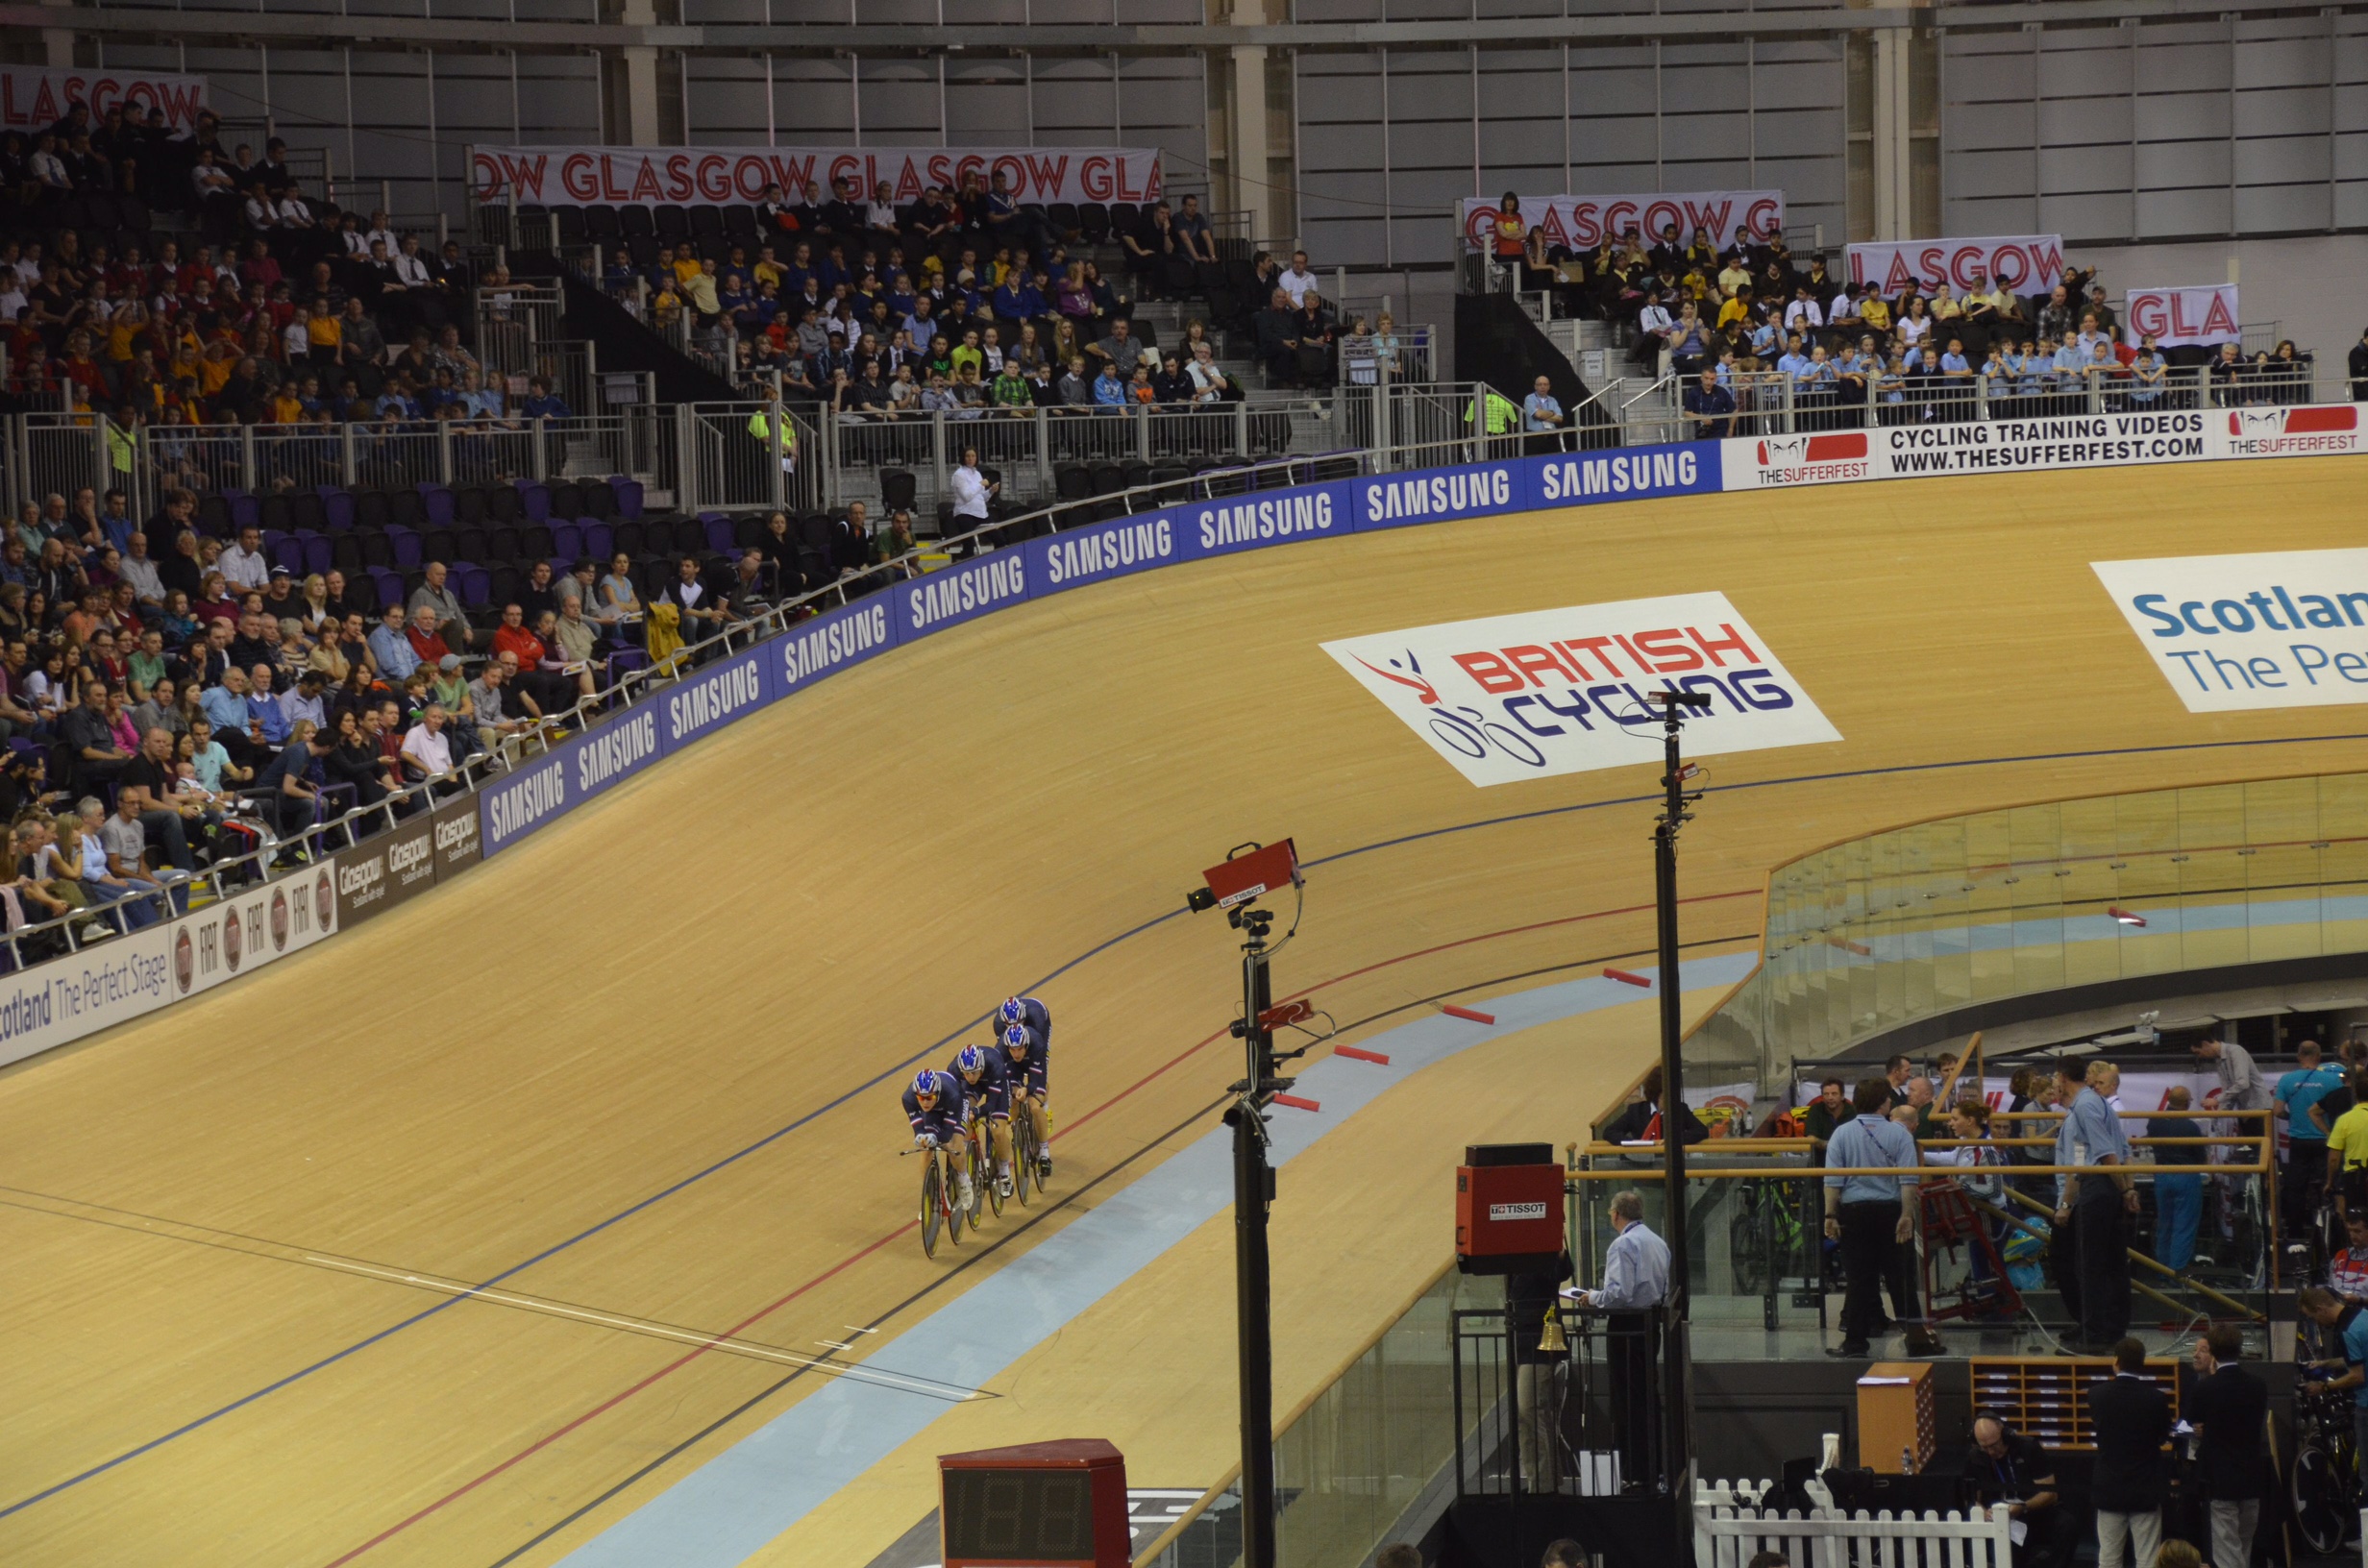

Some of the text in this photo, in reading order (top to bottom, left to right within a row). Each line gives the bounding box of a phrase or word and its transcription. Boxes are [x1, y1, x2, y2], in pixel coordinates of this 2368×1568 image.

[561, 154, 816, 201] GLASGOW
[828, 154, 1069, 201] GLASGOW
[1466, 199, 1780, 250] GASGOW G
[2131, 290, 2238, 338] GLA
[1890, 414, 2204, 449] CYCLING TRAINING VIDEOS
[1891, 437, 2204, 473] WWW.THESUFFERFEST.COM
[2229, 435, 2357, 453] THESUFFERFEST
[1367, 469, 1510, 522] SAMSUNG
[1543, 451, 1697, 501] SAMSUNG
[1758, 462, 1868, 484] THESUFFERFEST
[1199, 492, 1332, 549] SAMSUNG
[1048, 519, 1172, 583] SAMSUNG
[910, 555, 1024, 628] SAMSUNG
[784, 603, 886, 684] SAMSUNG
[1450, 624, 1761, 695] BRITISH
[2165, 644, 2368, 692] The Pe
[670, 659, 759, 740] SAMSUNG
[1502, 668, 1794, 737] CYCLING
[579, 711, 655, 792] SAMSUNG
[490, 761, 564, 843] SAMSUNG
[292, 884, 309, 935] FIAT
[1234, 886, 1263, 901] TISSOT
[200, 921, 217, 975] FIAT
[247, 902, 264, 955] FIAT
[56, 978, 81, 1020] The
[84, 962, 130, 1012] Perfect
[131, 953, 166, 996] Stage
[1506, 1203, 1545, 1213] TISSOT
